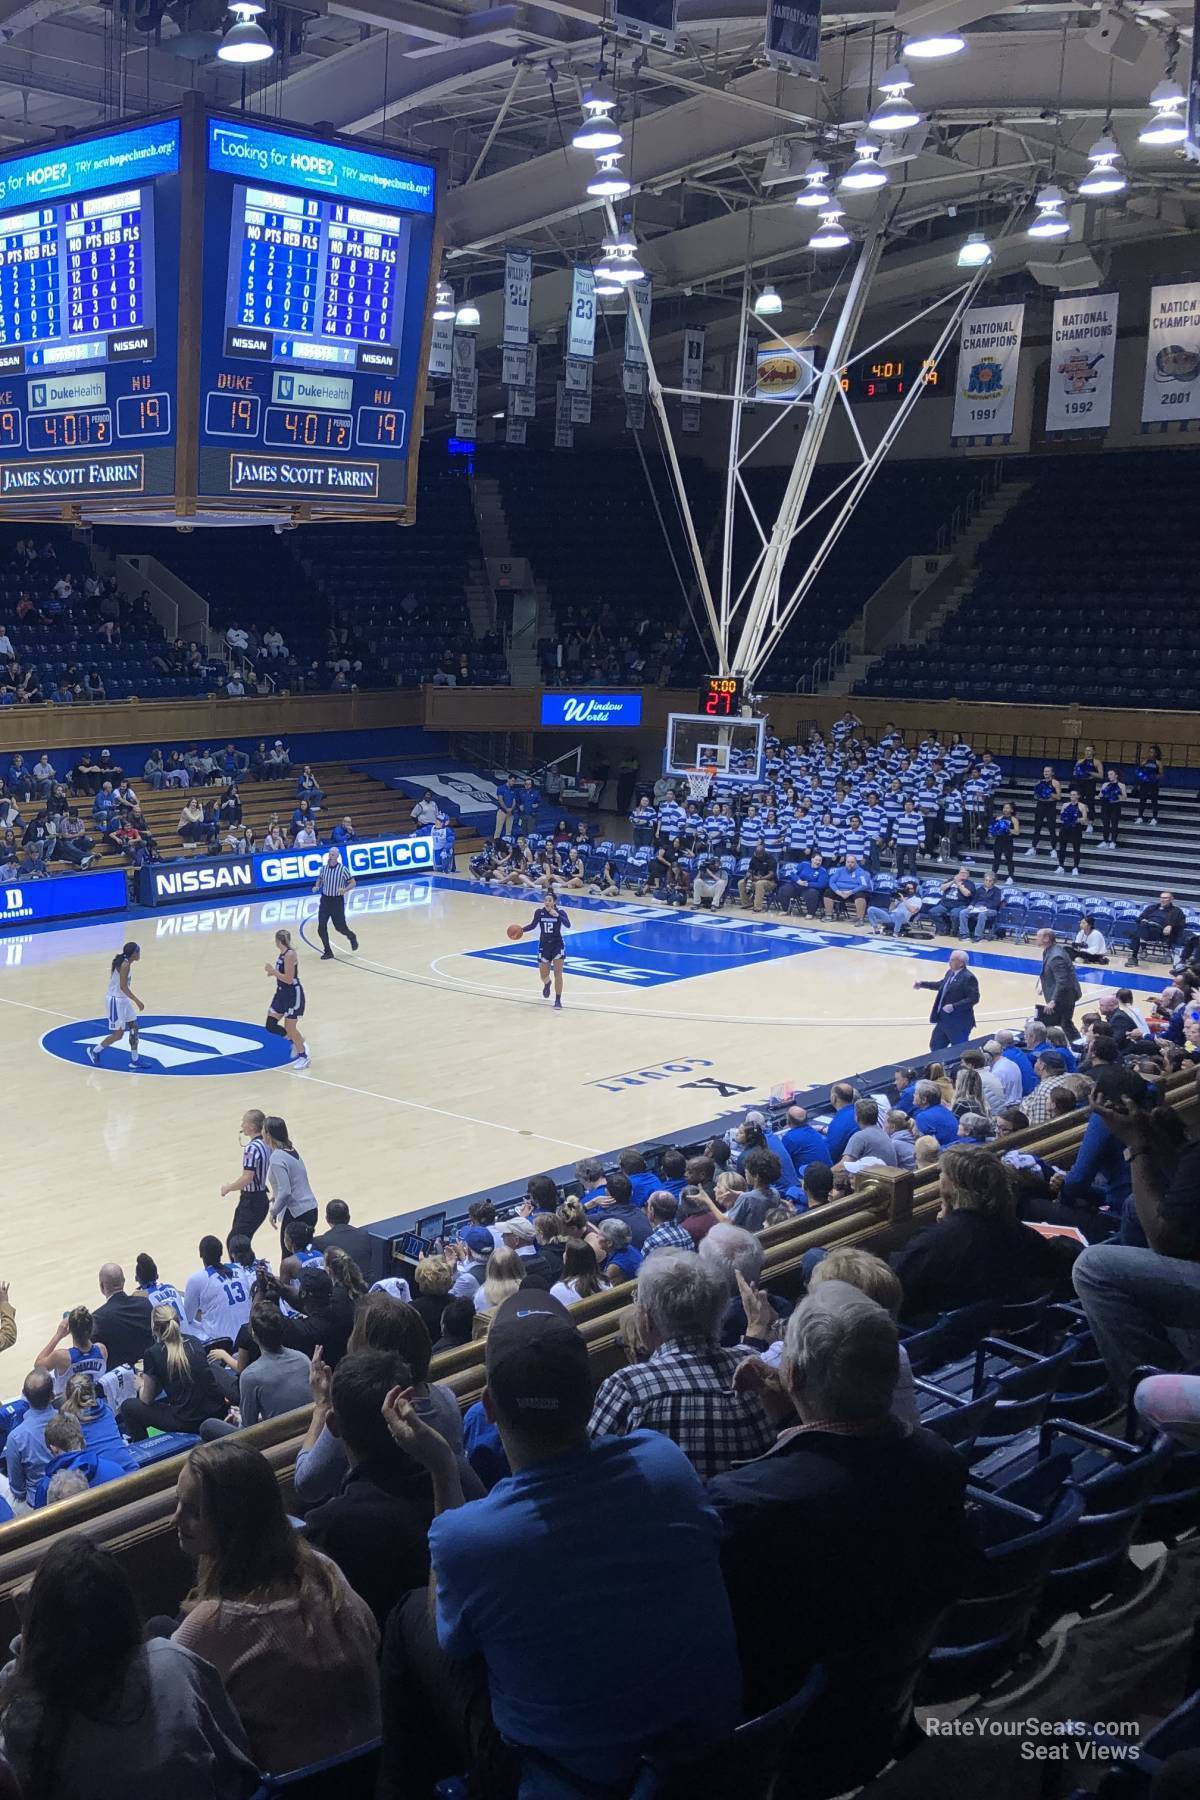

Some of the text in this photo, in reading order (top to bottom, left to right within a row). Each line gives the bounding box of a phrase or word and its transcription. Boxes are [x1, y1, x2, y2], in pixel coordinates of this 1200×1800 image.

[221, 138, 267, 169] Looking
[270, 150, 288, 166] for
[291, 154, 334, 176] HOPE?
[341, 166, 358, 179] TRY
[7, 175, 23, 189] for
[26, 162, 68, 186] HOPE?
[74, 160, 92, 173] TRY
[69, 226, 140, 253] NO PTS REB FLS
[247, 225, 318, 250] NO PTS REB FLS
[7, 250, 23, 264] PTS
[24, 246, 40, 261] REB
[42, 242, 57, 257] FLS
[72, 254, 80, 267] 10
[330, 240, 396, 264] NO PTS REB FLS
[72, 271, 81, 284] 12
[72, 287, 81, 300] 21
[72, 302, 83, 316] 24
[575, 298, 593, 320] 23
[72, 318, 83, 331] 44
[970, 320, 1014, 336] NATIONAL
[1062, 311, 1109, 327] NATIONAL
[963, 334, 1018, 350] CHAMPIONS
[1055, 324, 1113, 342] CHAMPIONS
[113, 338, 148, 352] NISSAN
[232, 338, 267, 351] NISSAN
[362, 353, 393, 367] NISSAN
[871, 363, 902, 377] 4:01
[217, 373, 254, 391] DUKE
[50, 383, 102, 401] DukeHealth
[297, 383, 349, 401] DukeHealth
[1161, 391, 1191, 405] 2001
[140, 398, 160, 429] 19
[231, 400, 252, 430] 19
[970, 408, 997, 421] 1991
[1064, 401, 1093, 414] 1992
[97, 422, 106, 441] 2
[285, 413, 332, 445] 4:01
[337, 427, 346, 445] 2
[377, 413, 396, 441] 19
[3, 464, 139, 491] JAMES SCOTT FARRIN
[235, 461, 374, 487] JAMES SCOTT FARRIN
[710, 680, 736, 693] 4:00
[563, 698, 623, 721] Window
[705, 692, 731, 714] 27
[350, 841, 431, 872] GEICO
[156, 864, 251, 896] NISSAN
[543, 922, 554, 934] 12
[676, 1077, 758, 1098] K
[223, 1281, 247, 1306] 13
